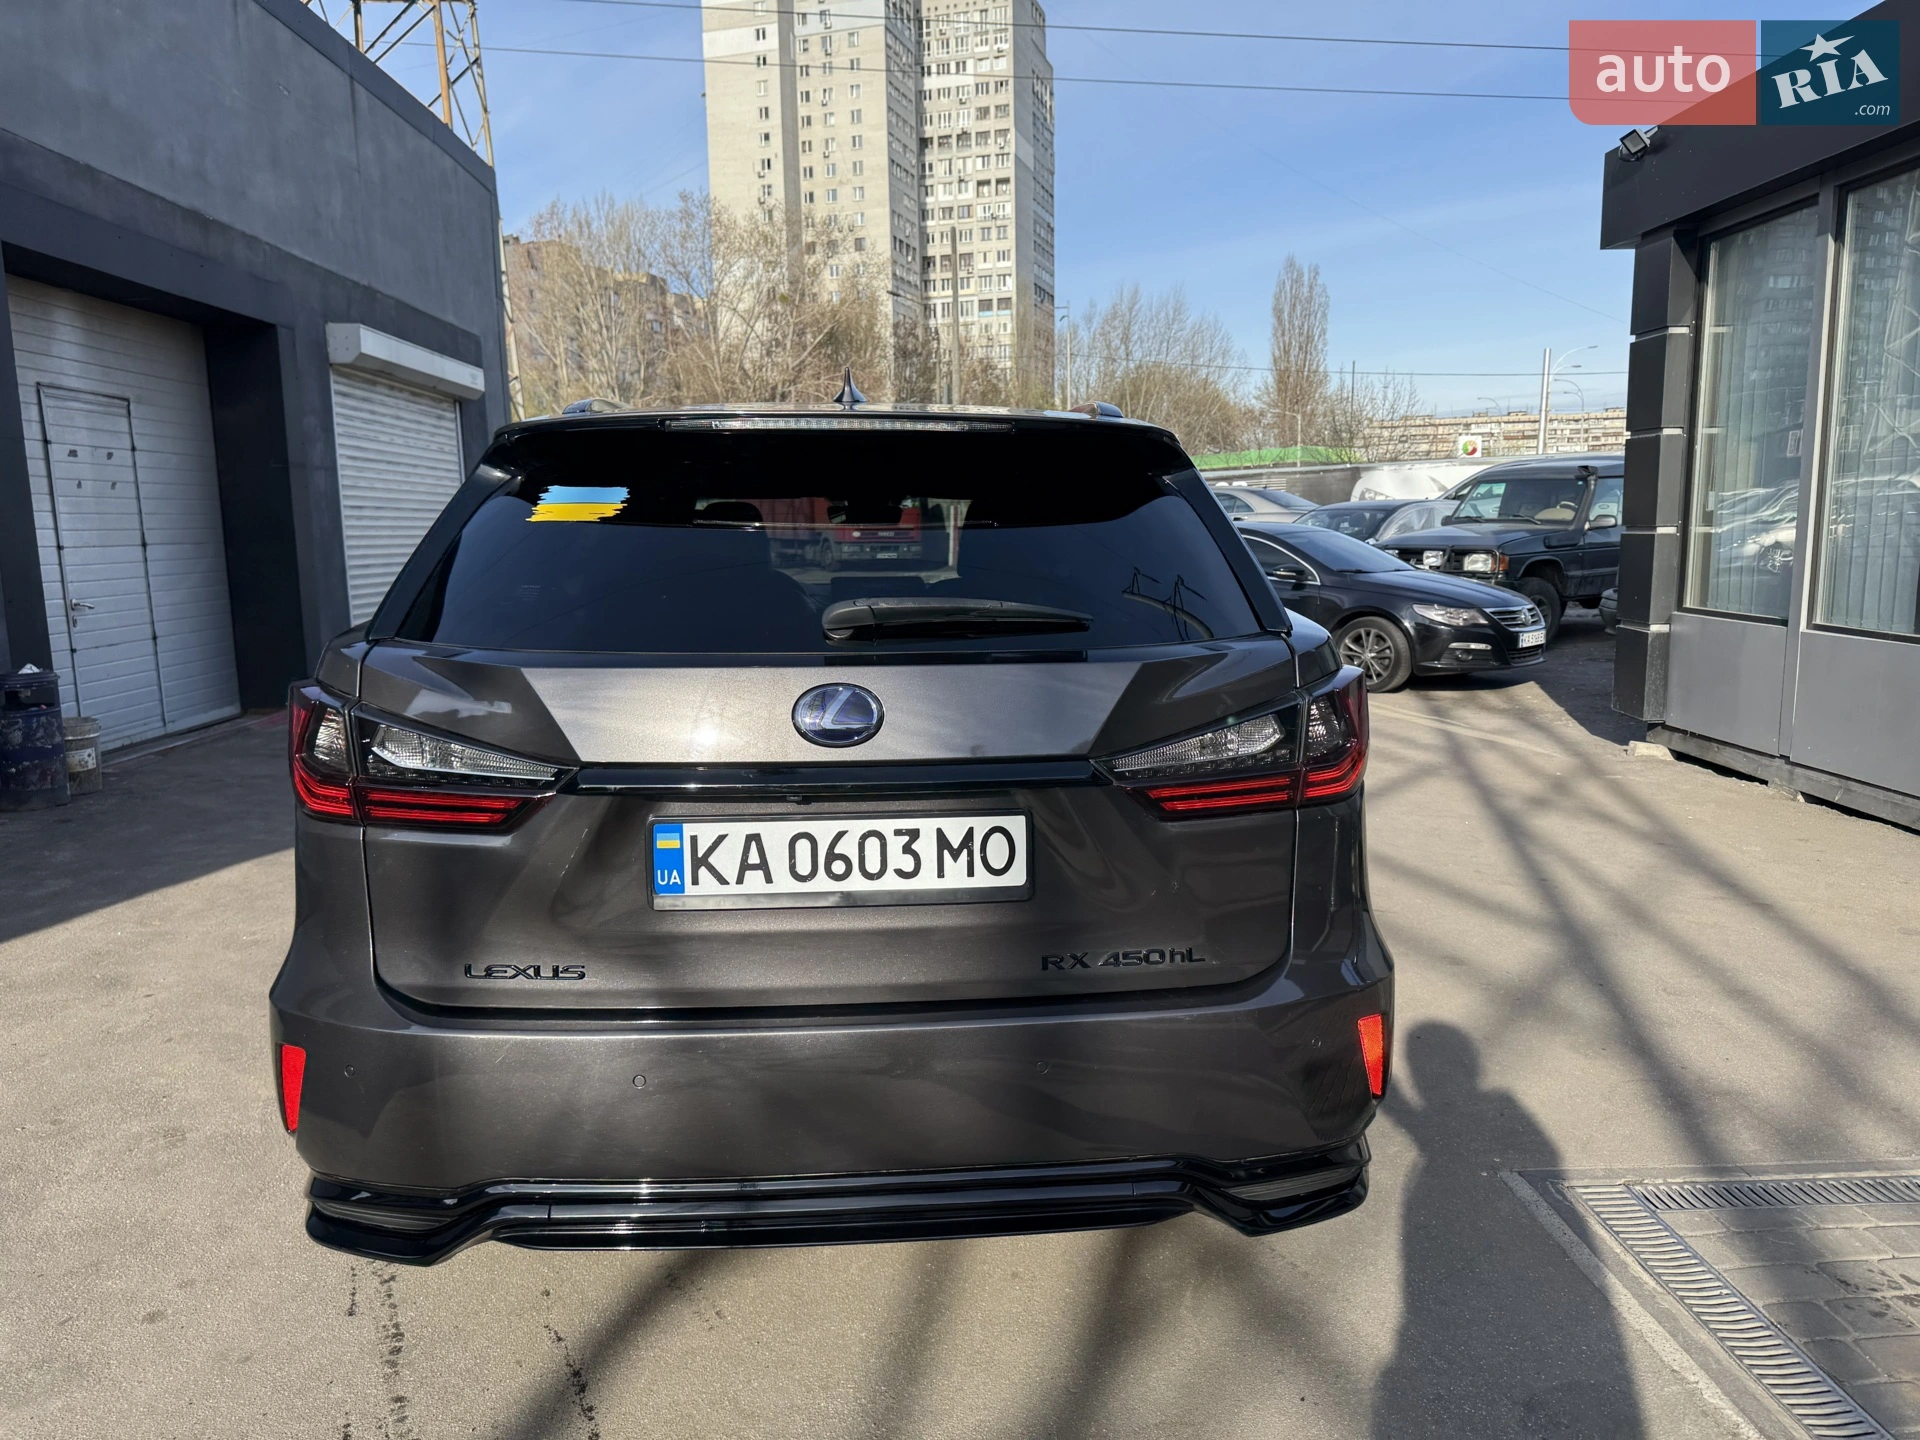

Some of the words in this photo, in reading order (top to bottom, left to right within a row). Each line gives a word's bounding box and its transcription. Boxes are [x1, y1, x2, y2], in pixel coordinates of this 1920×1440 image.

[689, 832, 774, 886] KA
[788, 828, 922, 883] 0603
[936, 825, 1016, 879] MO
[656, 868, 682, 886] UA
[1041, 952, 1092, 971] RX
[464, 963, 586, 981] LEXUS
